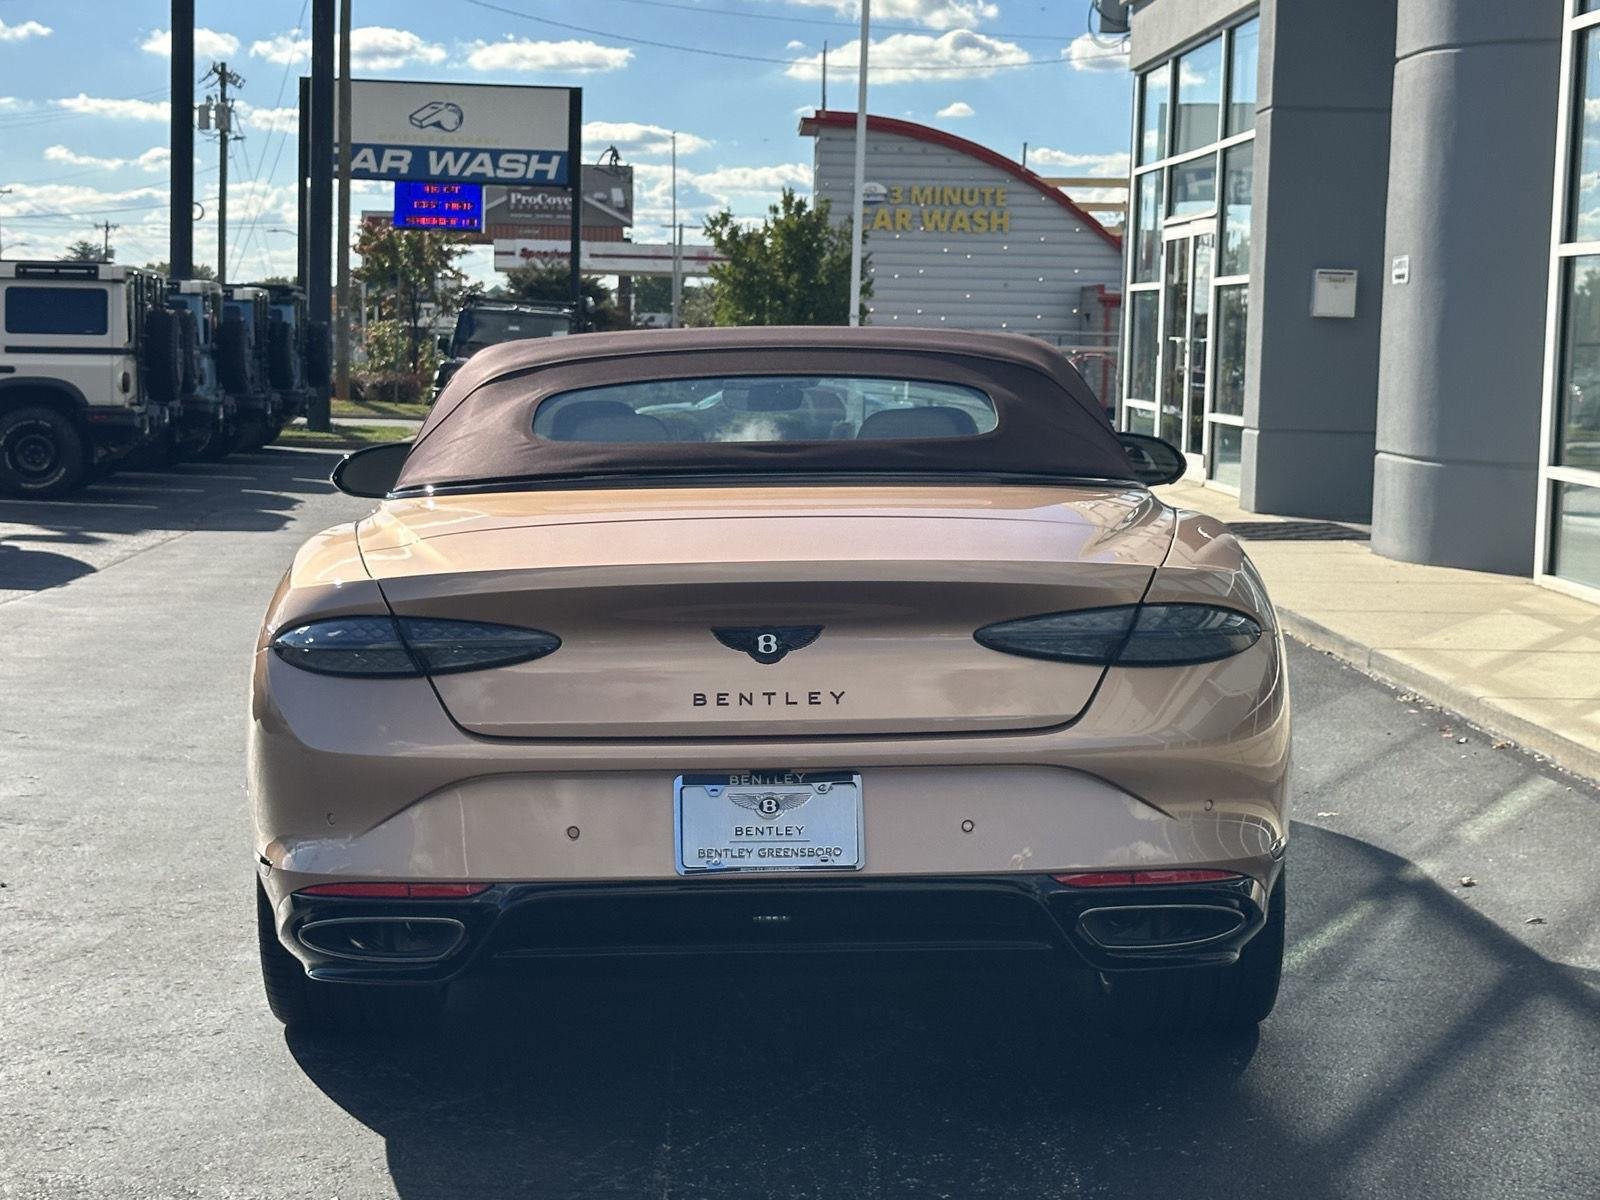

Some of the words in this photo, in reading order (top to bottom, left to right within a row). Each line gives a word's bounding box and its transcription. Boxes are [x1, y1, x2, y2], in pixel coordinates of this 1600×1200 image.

[333, 147, 413, 174] AR
[428, 150, 561, 180] WASH
[510, 191, 572, 206] ProCove
[889, 184, 903, 204] 3
[911, 185, 1008, 207] MINUTE
[922, 208, 1010, 233] WASH
[757, 633, 778, 654] B
[693, 691, 845, 706] BENTLEY
[761, 798, 778, 813] B
[734, 825, 805, 836] BENTLEY
[697, 848, 753, 859] BENTLEY
[757, 846, 843, 858] GREENSBORO
